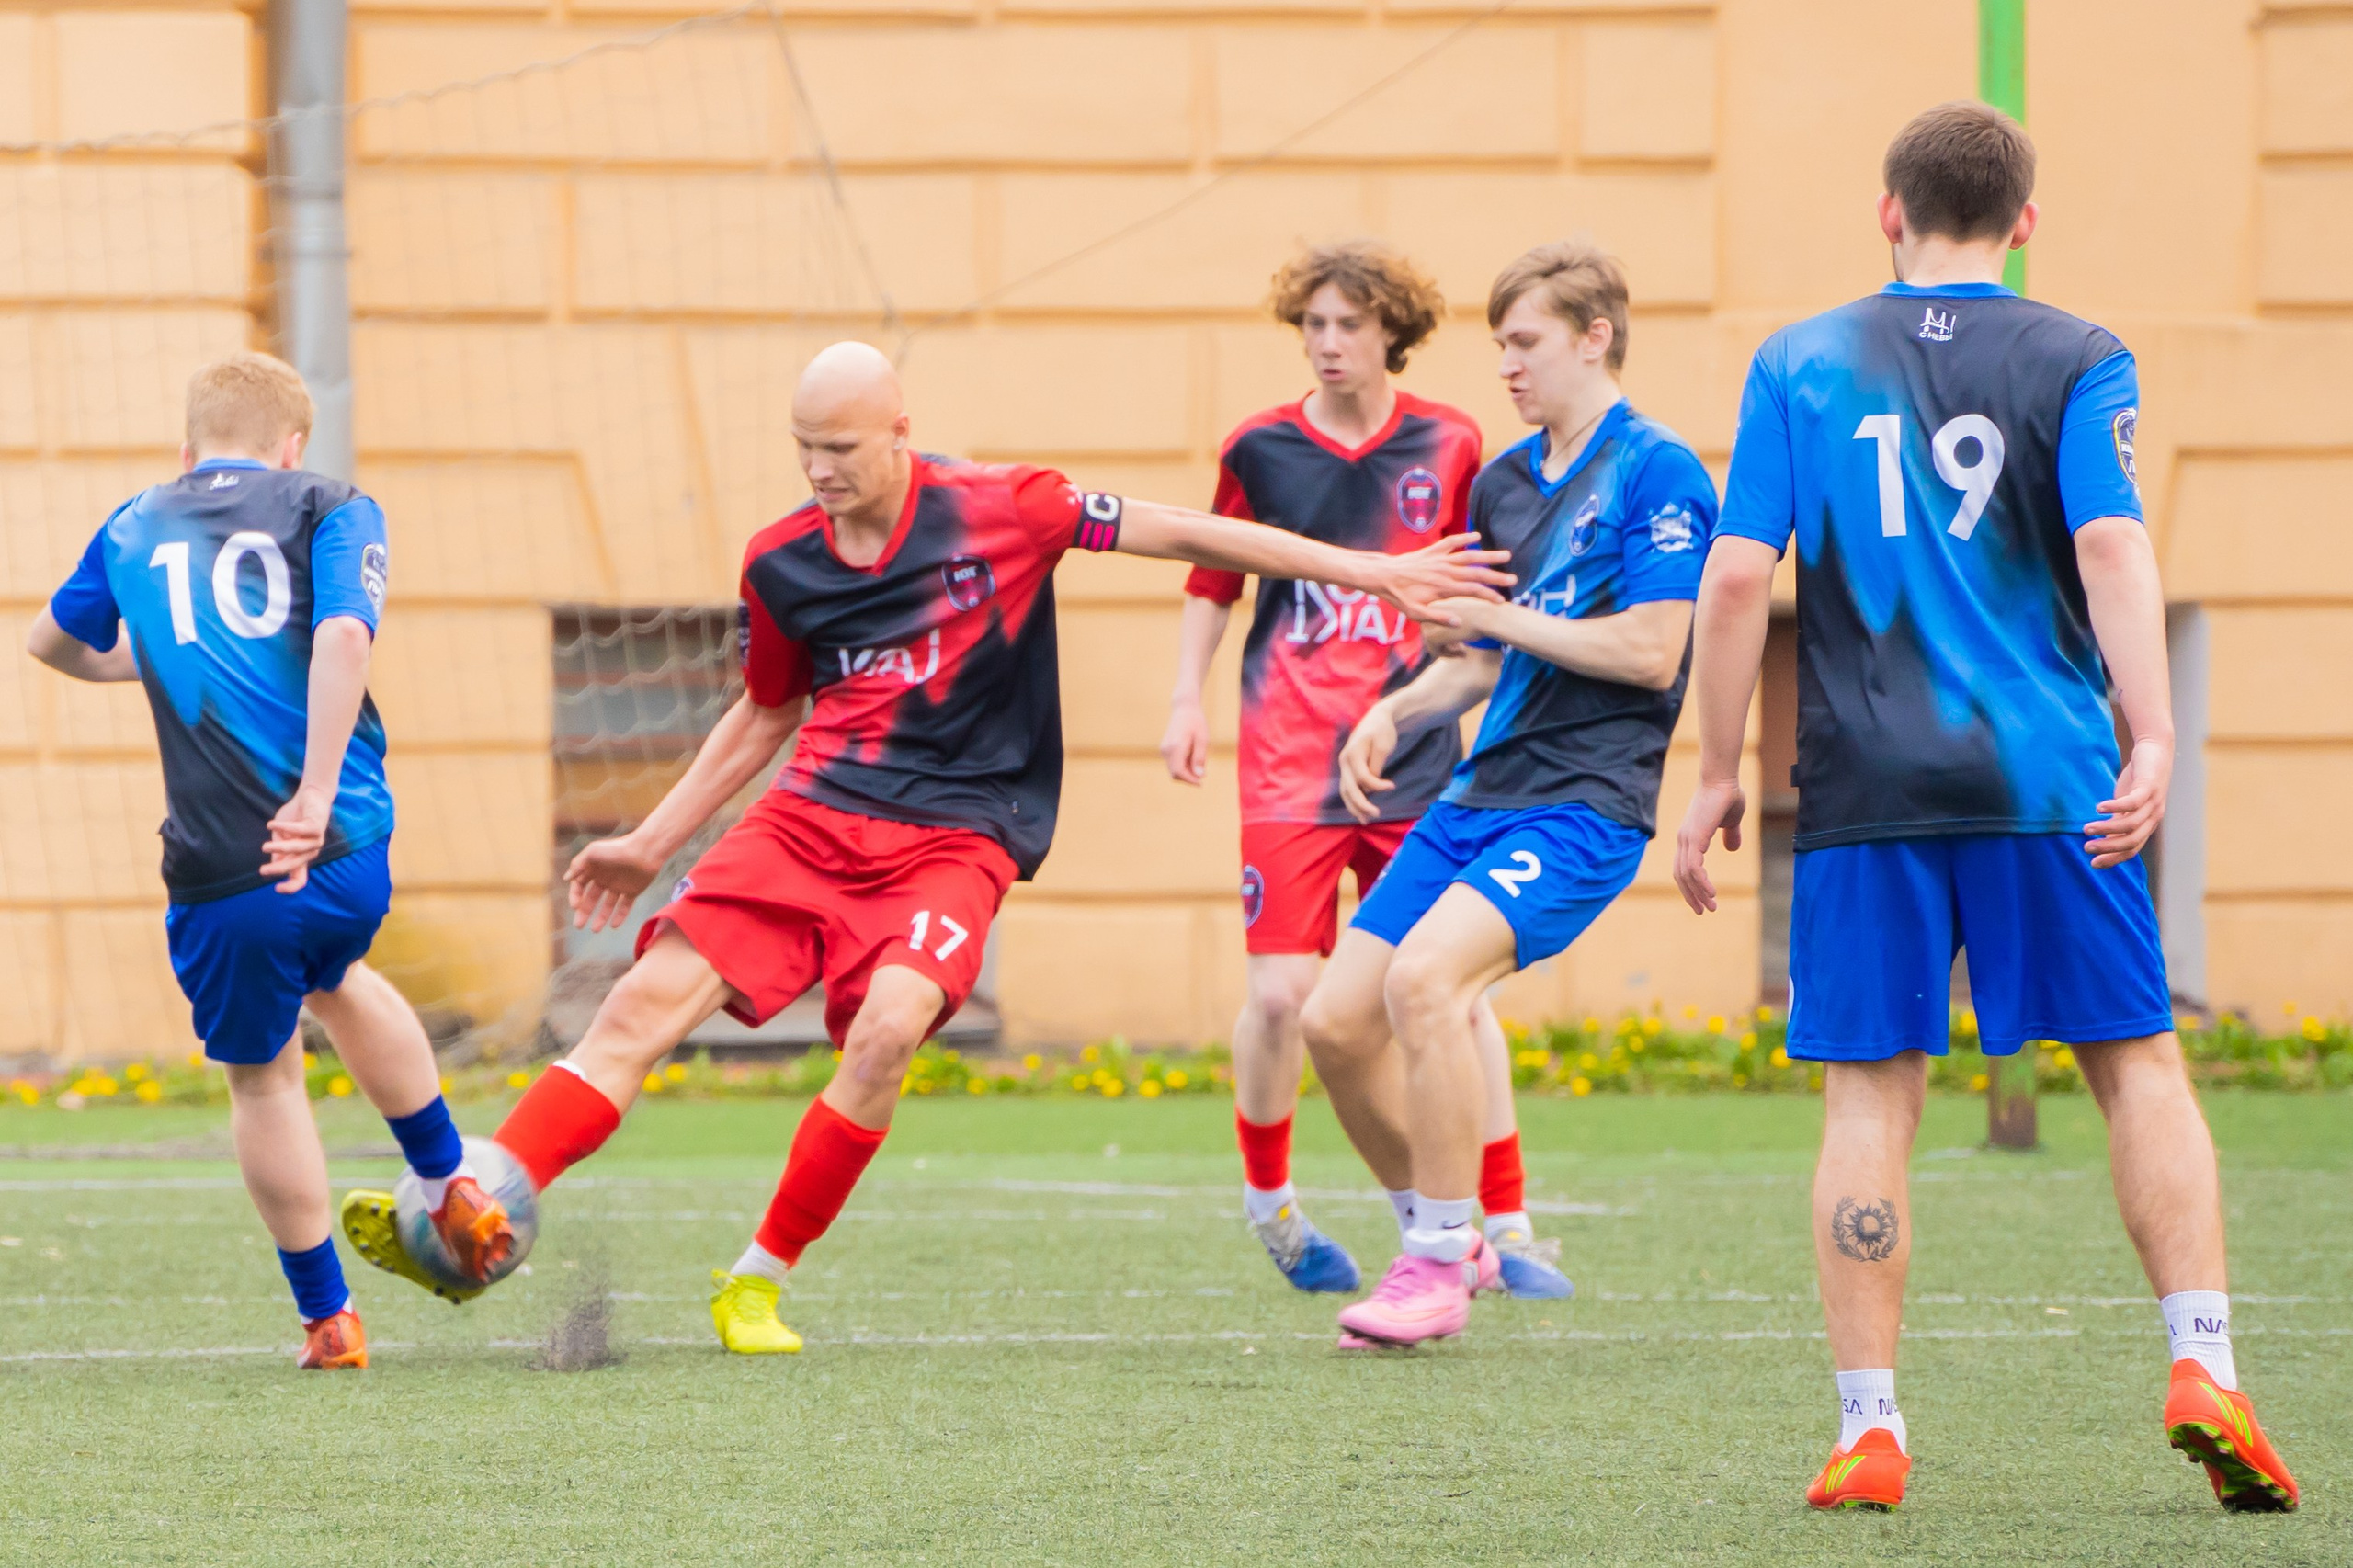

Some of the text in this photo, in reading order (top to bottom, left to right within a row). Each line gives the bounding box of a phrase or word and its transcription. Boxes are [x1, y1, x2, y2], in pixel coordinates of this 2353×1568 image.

[1852, 414, 2005, 541] 19
[1086, 493, 1120, 521] C
[149, 531, 292, 645] 10
[1487, 849, 1542, 898] 2
[908, 910, 969, 961] 17
